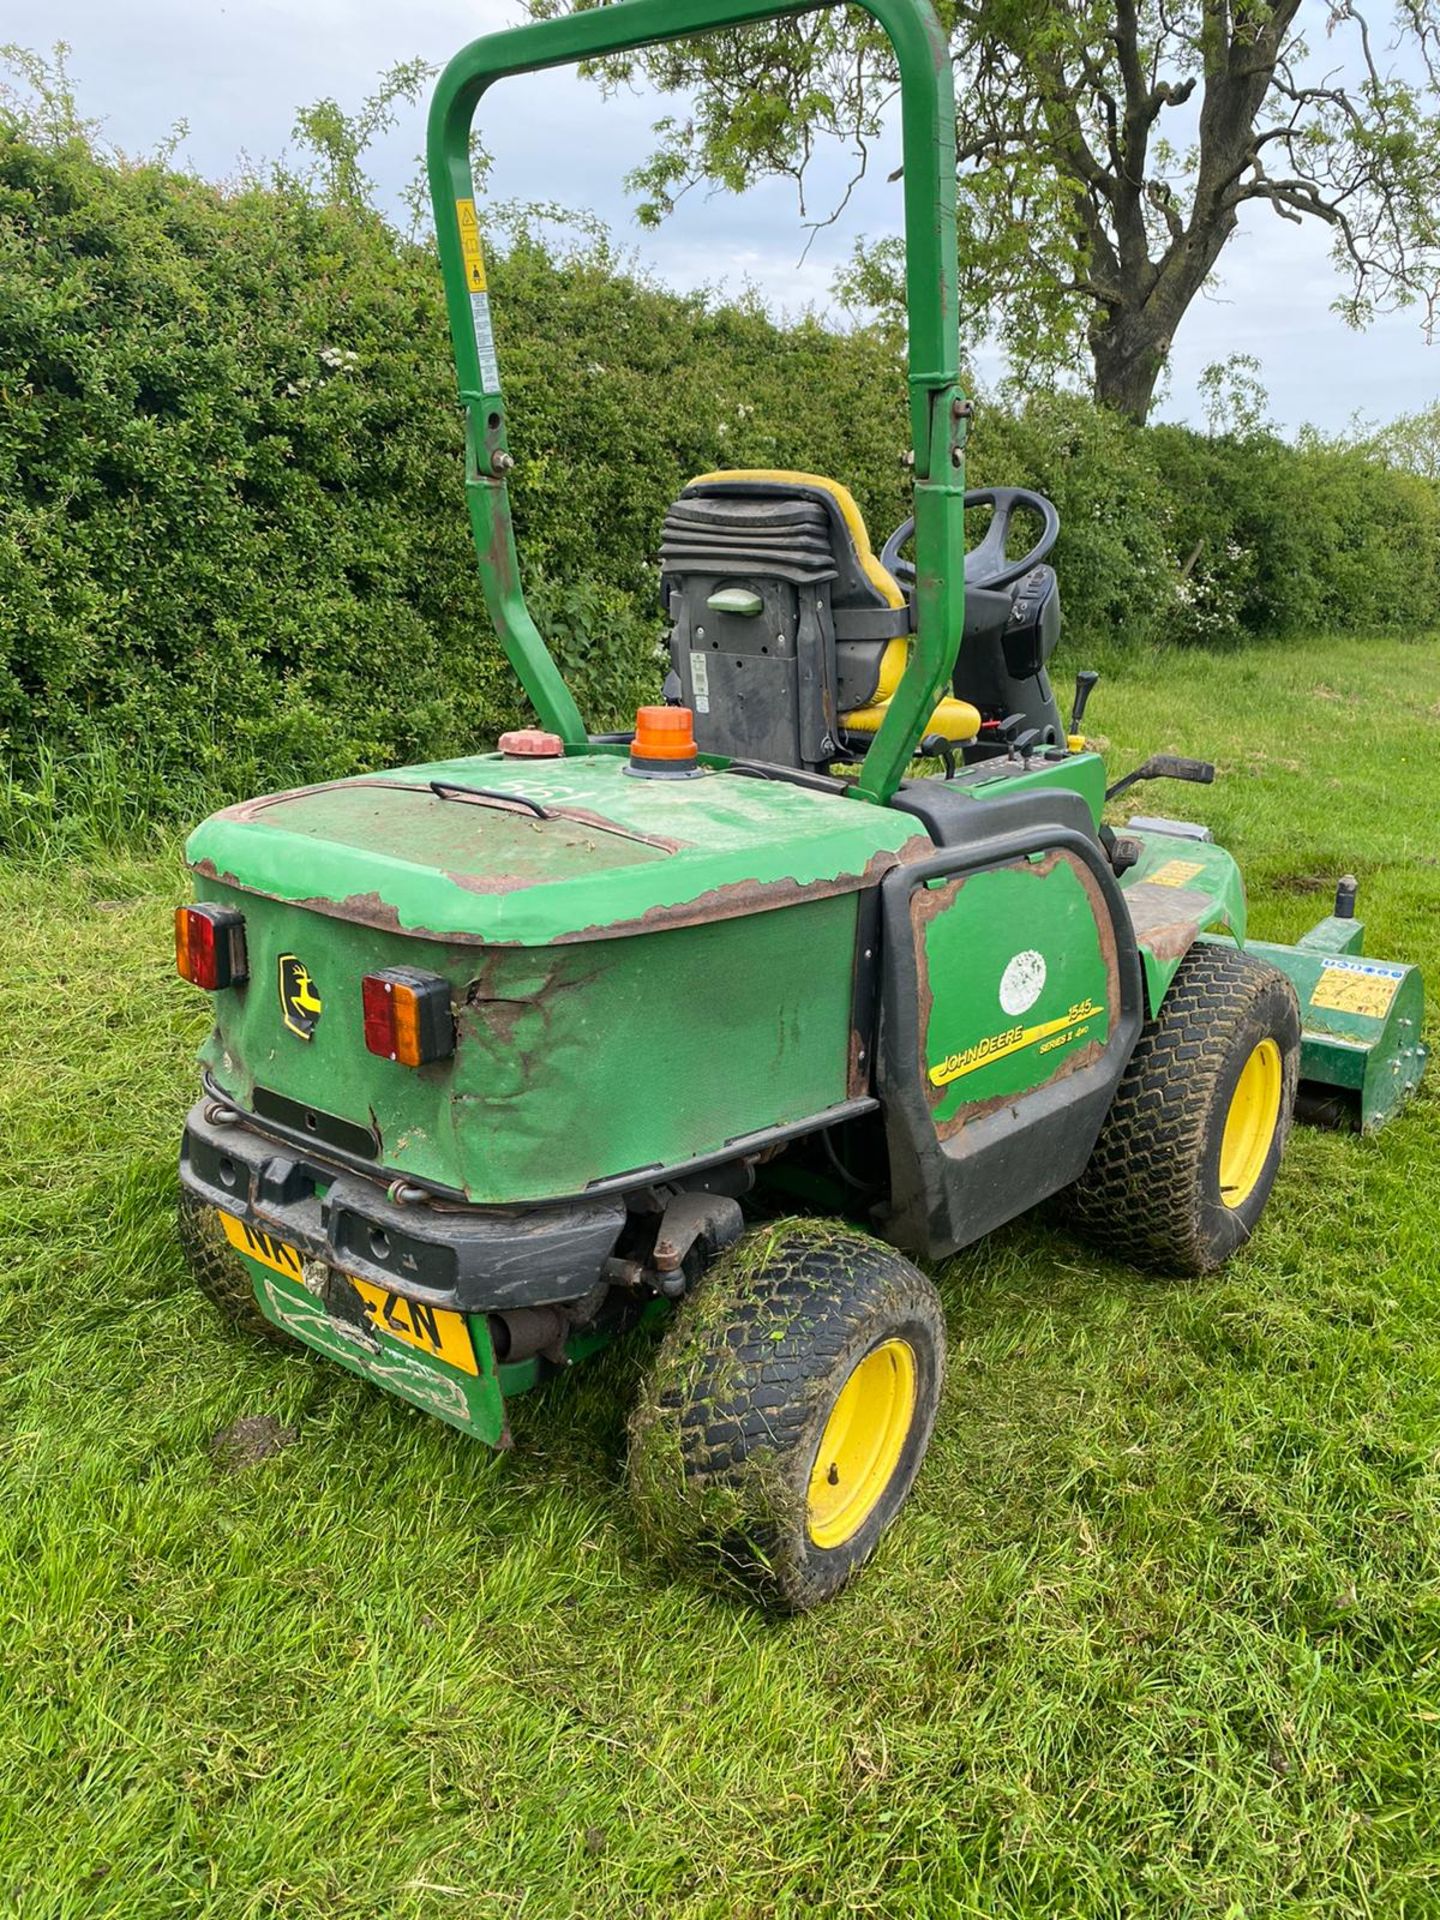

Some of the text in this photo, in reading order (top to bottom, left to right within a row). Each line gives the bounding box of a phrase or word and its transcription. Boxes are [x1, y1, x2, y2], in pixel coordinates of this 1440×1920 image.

[938, 998, 1092, 1077] JOHN DEERE 1545
[1039, 1034, 1067, 1054] SERIES
